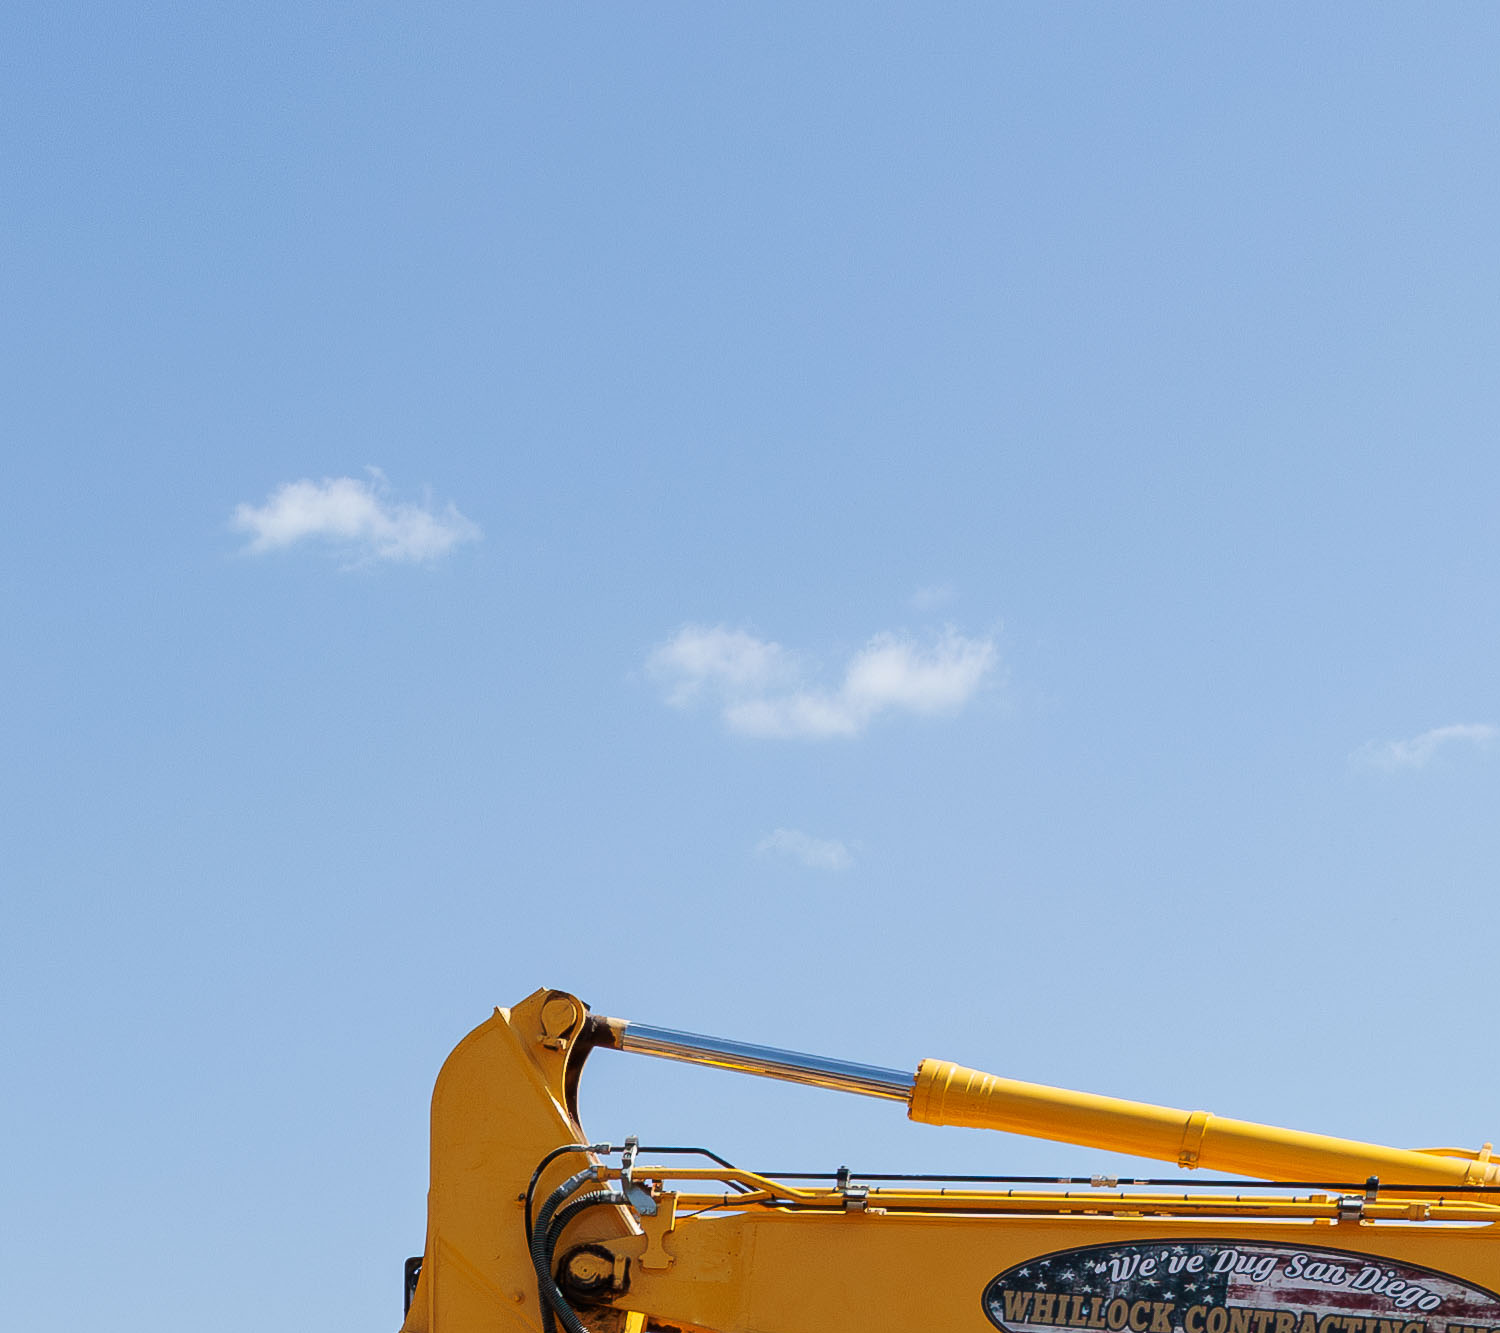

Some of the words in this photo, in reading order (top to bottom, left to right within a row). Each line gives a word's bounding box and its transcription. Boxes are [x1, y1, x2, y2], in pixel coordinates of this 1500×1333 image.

[1213, 1249, 1279, 1281] Dug
[1284, 1254, 1346, 1285] San
[1351, 1266, 1442, 1311] Diego
[1003, 1290, 1175, 1333] WHILLOCK
